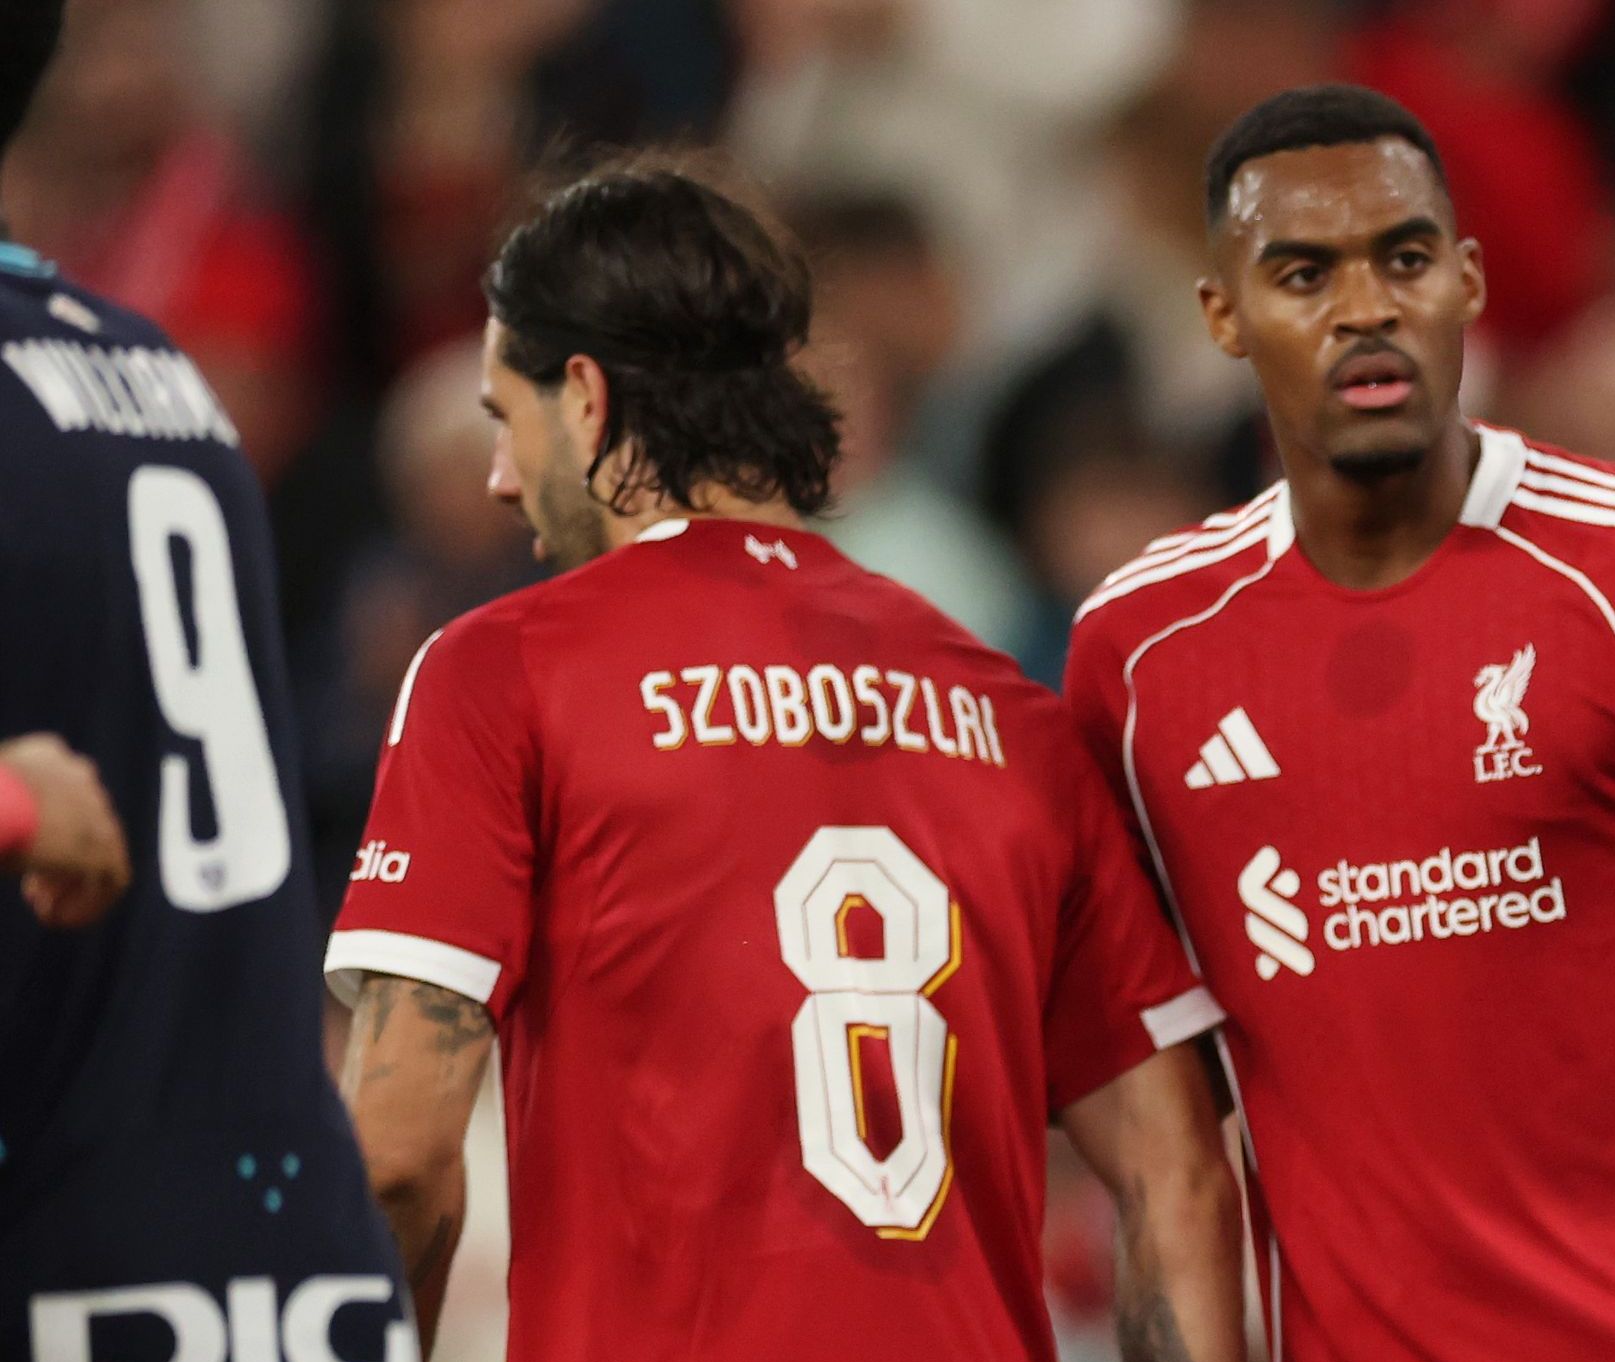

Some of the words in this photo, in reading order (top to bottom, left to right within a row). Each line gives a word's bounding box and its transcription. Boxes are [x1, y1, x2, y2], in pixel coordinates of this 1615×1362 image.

[129, 465, 291, 912] 9
[639, 663, 1006, 768] SZOBOSZLAI
[1317, 836, 1545, 908] standard
[1322, 876, 1568, 952] chartered
[773, 825, 962, 1241] 8
